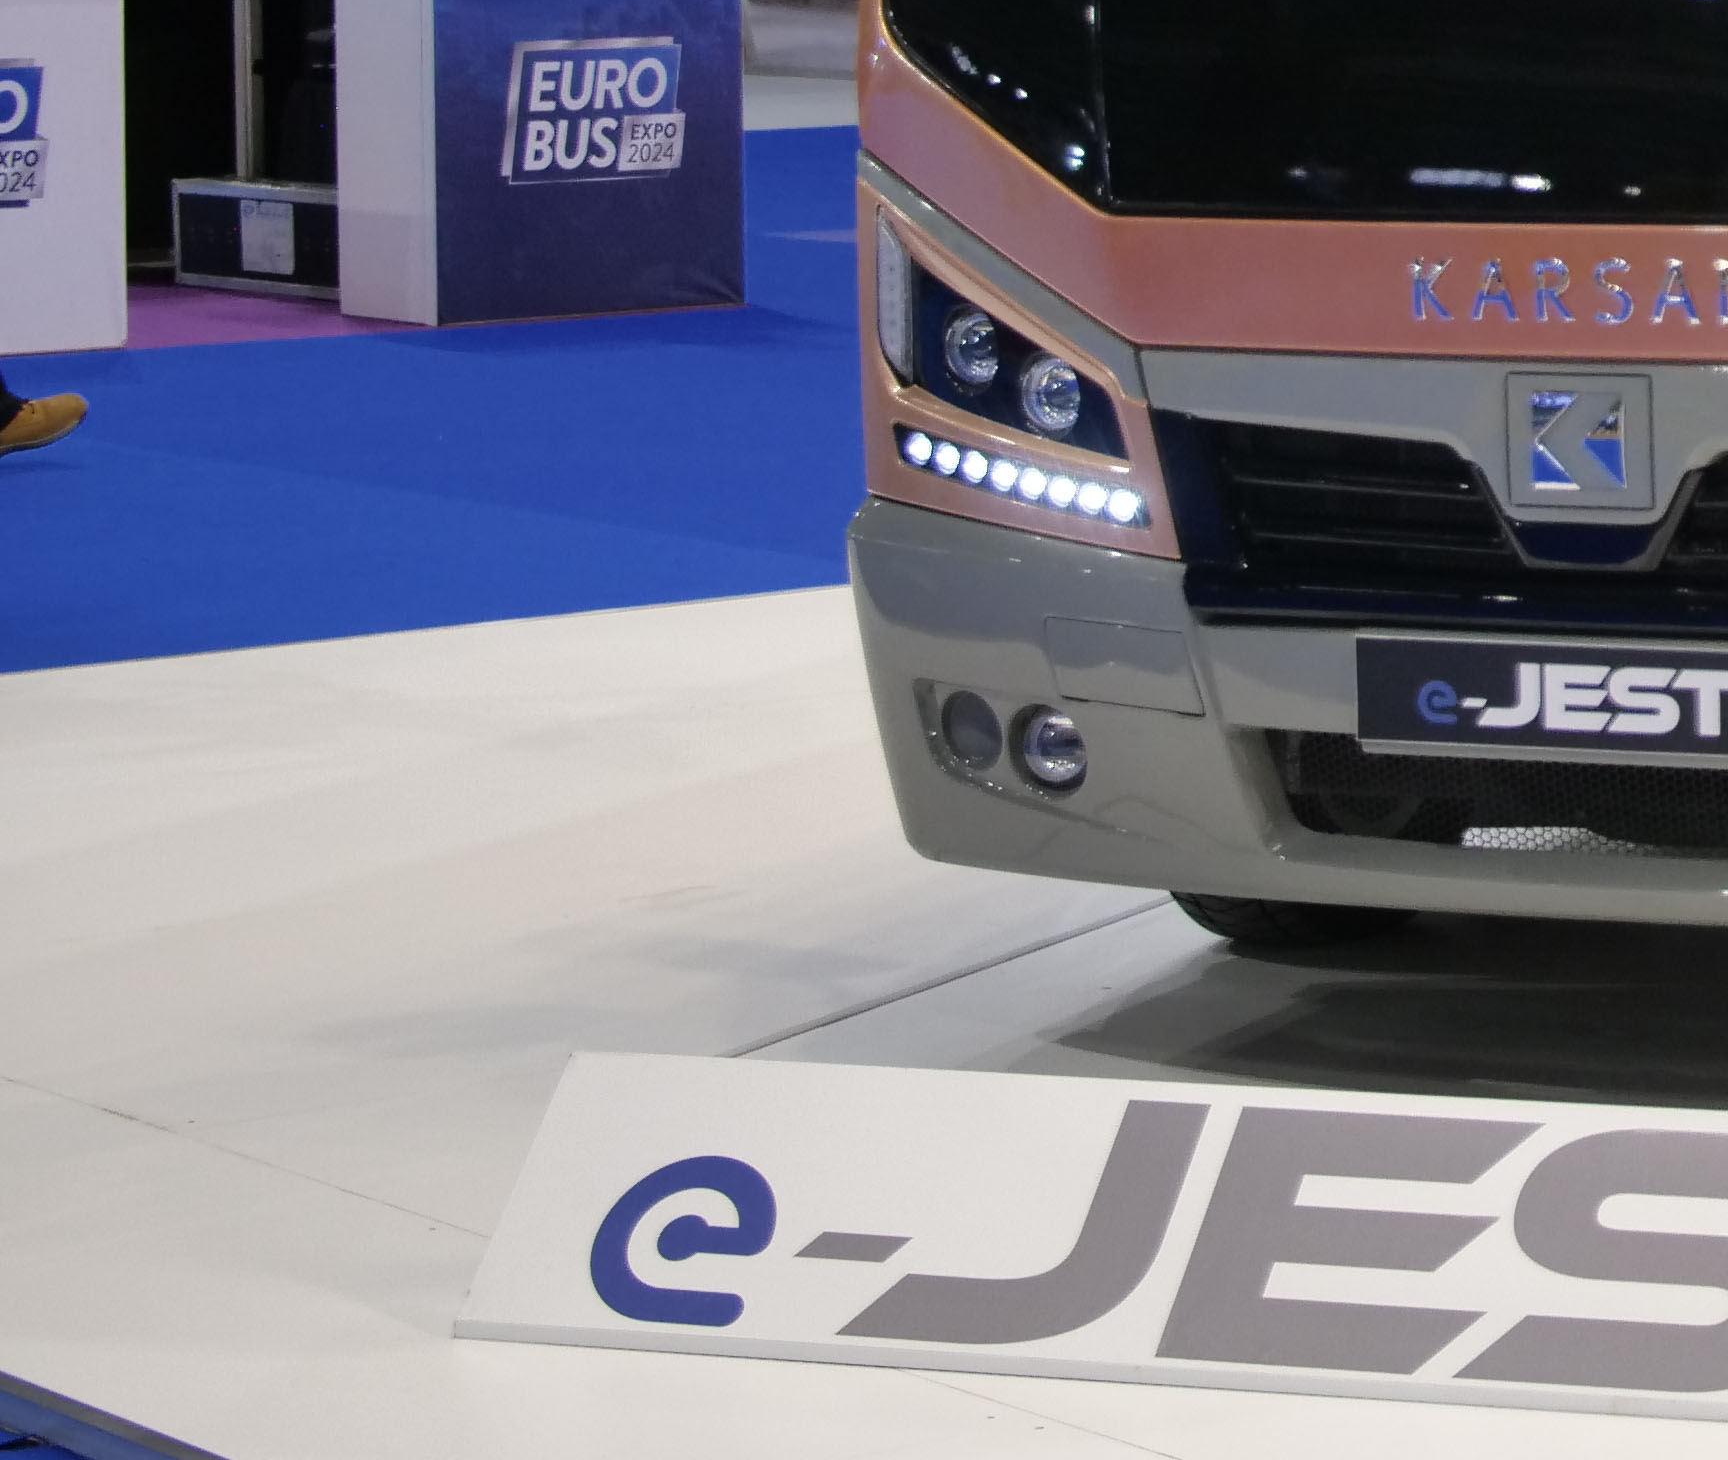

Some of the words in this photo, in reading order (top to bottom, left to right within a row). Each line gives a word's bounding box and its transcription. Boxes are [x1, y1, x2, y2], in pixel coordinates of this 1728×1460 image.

[529, 57, 667, 112] EURO
[523, 117, 619, 172] BUS
[630, 123, 677, 141] EXPO
[628, 143, 675, 163] 2024
